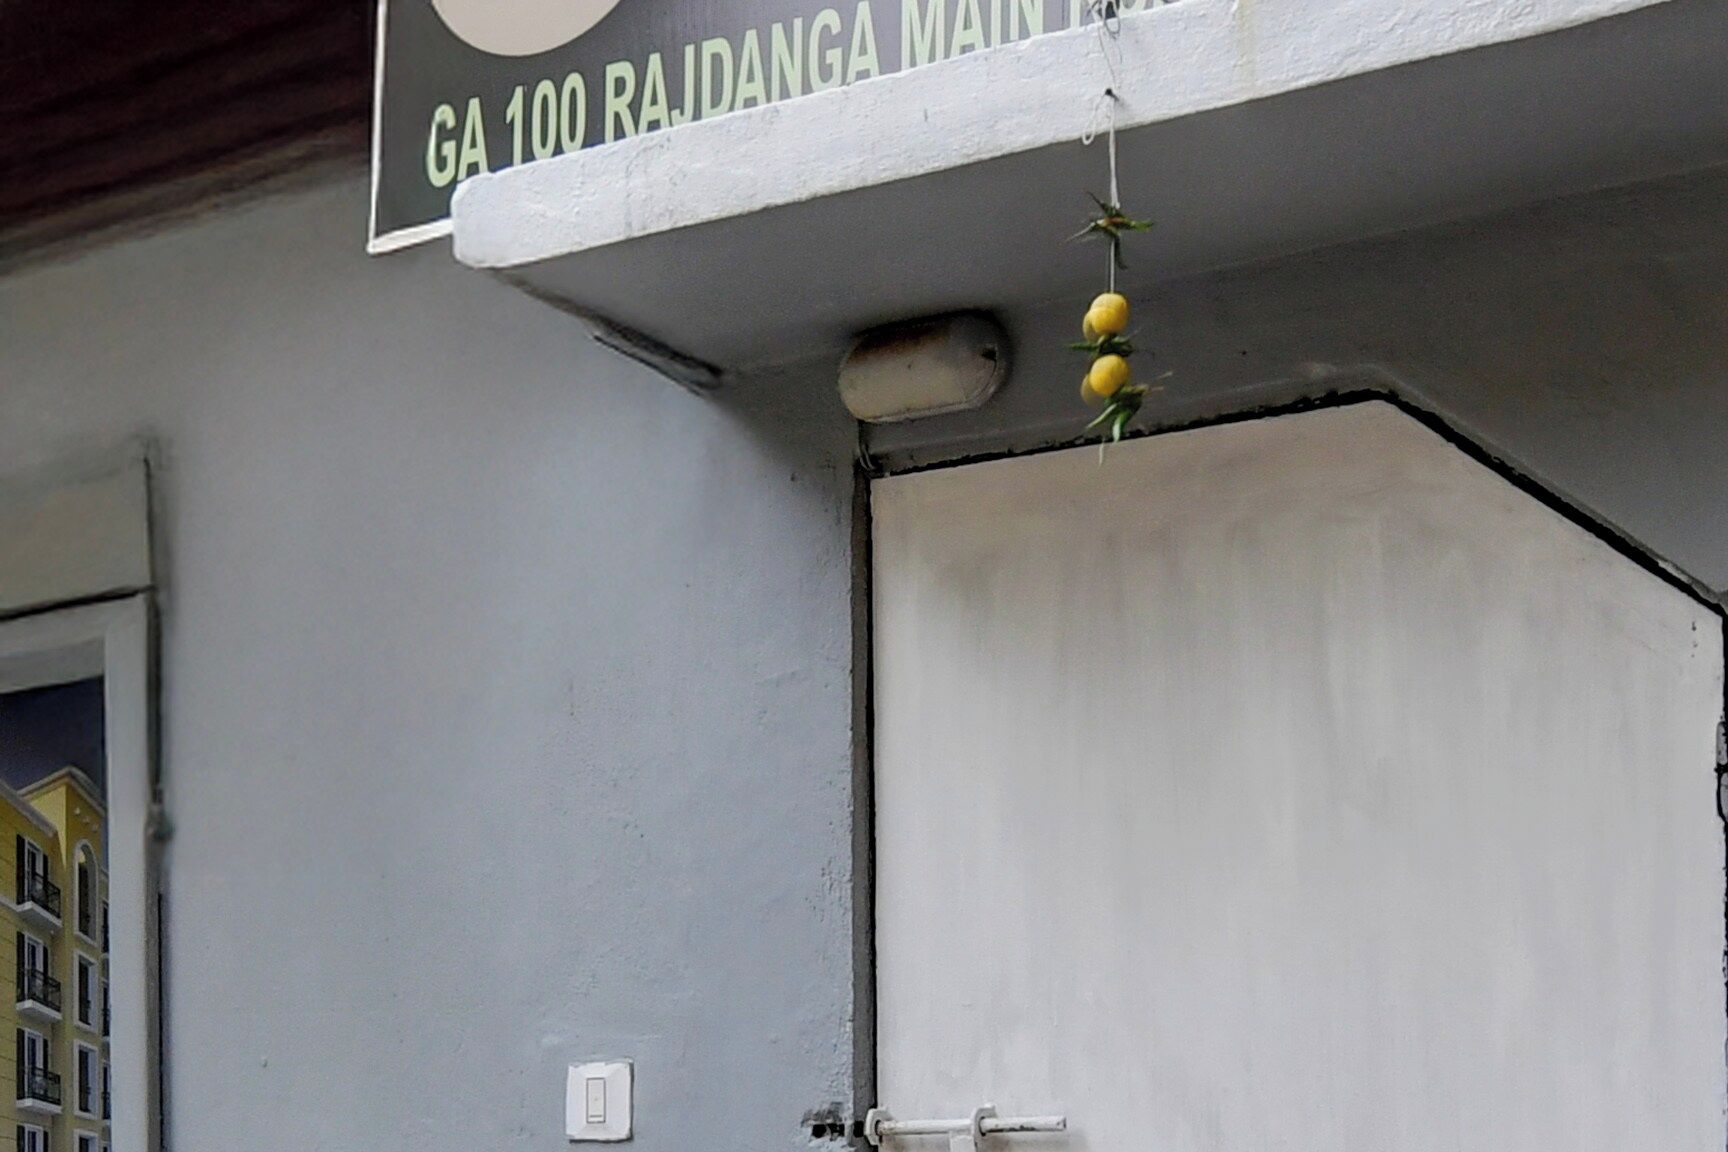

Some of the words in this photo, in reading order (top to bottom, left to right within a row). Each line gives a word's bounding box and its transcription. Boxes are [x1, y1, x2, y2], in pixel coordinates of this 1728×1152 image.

[427, 97, 489, 187] GA
[505, 73, 586, 166] 100
[605, 0, 880, 143] RAJDANGA
